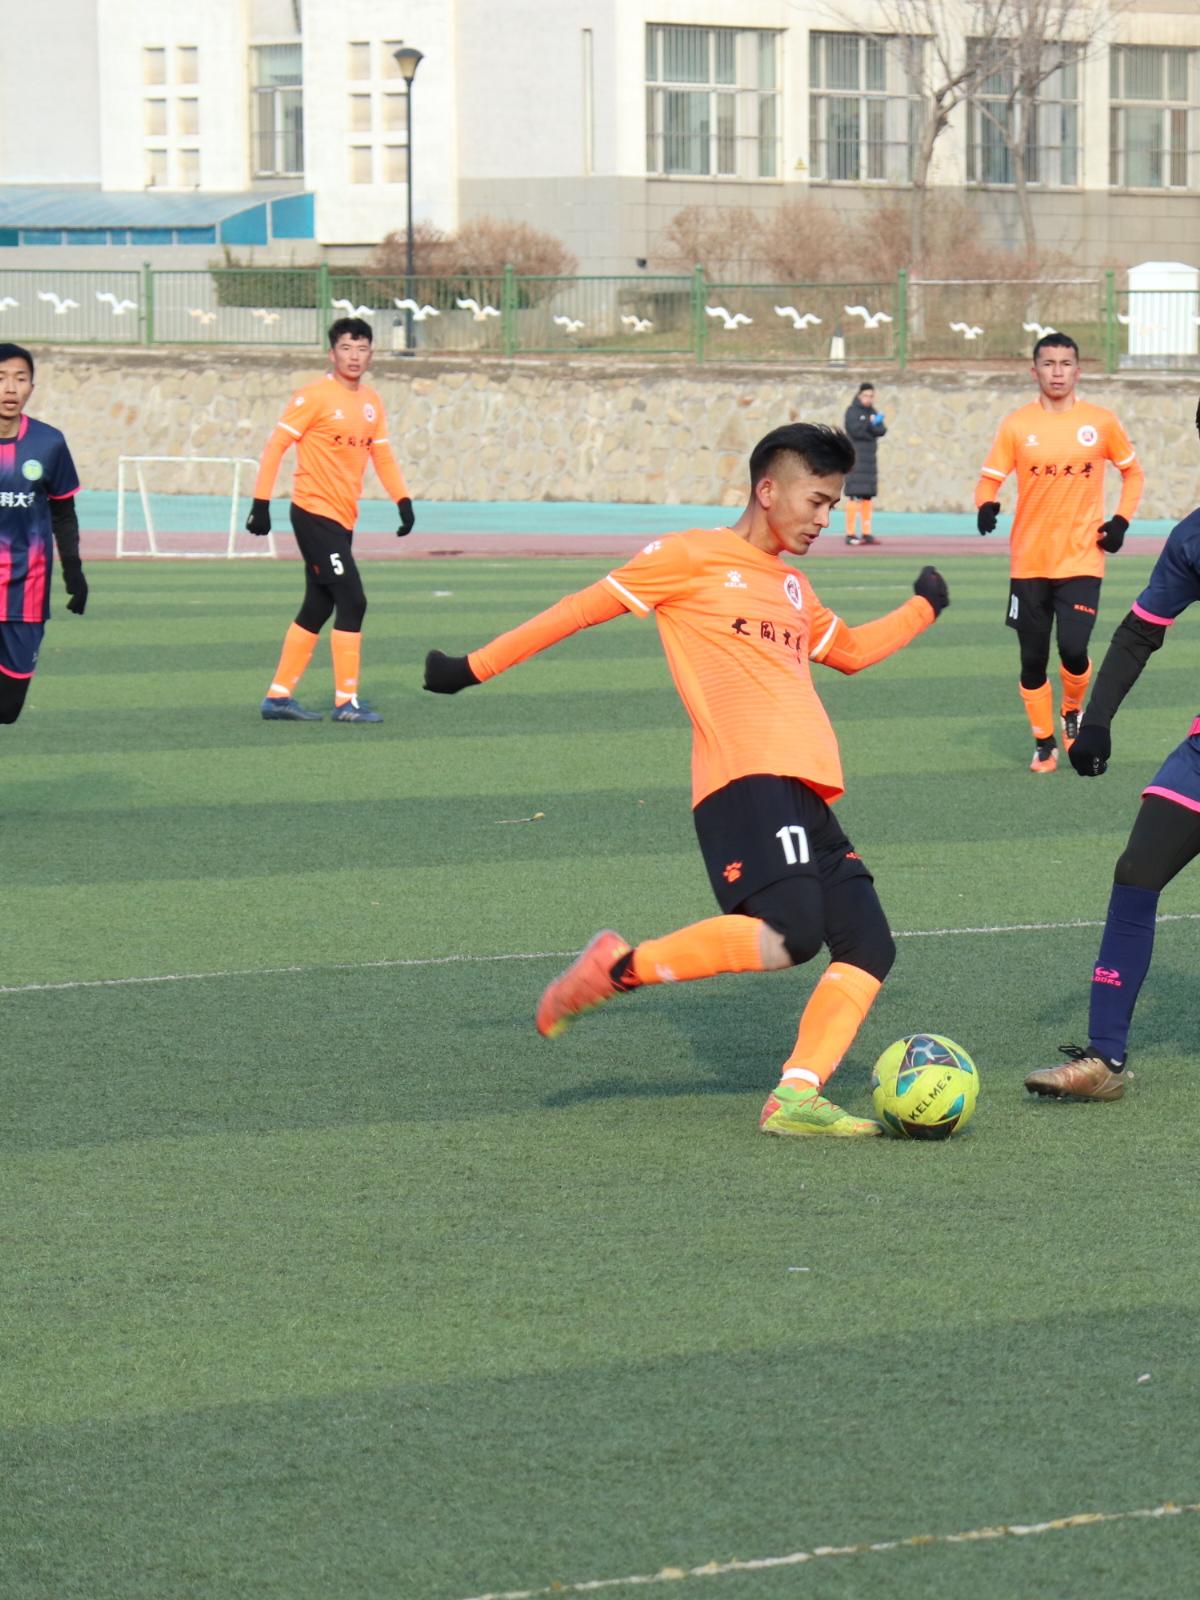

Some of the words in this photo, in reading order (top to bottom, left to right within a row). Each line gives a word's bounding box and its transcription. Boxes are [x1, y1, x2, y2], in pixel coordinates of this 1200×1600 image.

[330, 552, 345, 577] 5
[775, 825, 810, 865] 17
[908, 1079, 947, 1121] KELME
